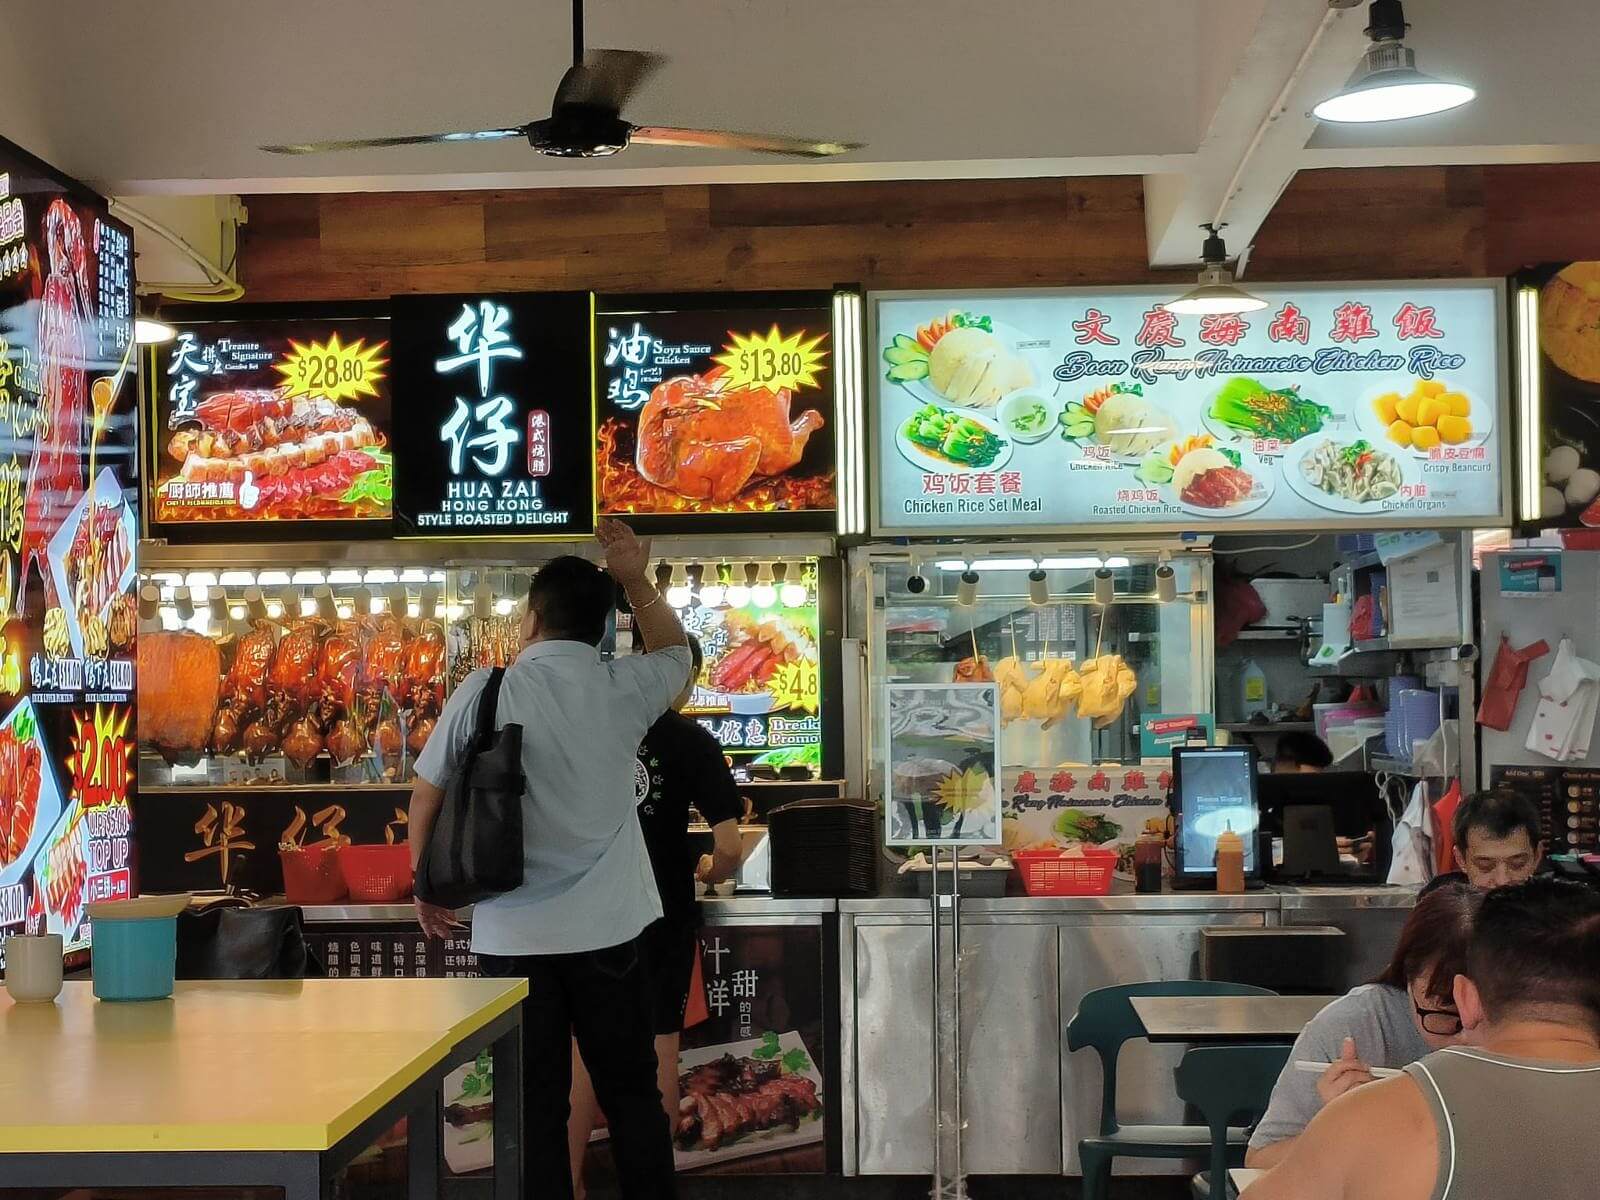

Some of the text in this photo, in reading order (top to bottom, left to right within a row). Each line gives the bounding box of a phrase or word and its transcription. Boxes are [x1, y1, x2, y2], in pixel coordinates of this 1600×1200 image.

[217, 337, 260, 353] Treasure
[652, 339, 711, 358] Soya Sauce
[231, 351, 273, 363] Signature
[655, 356, 690, 365] Chicken
[1053, 350, 1130, 381] Boon
[1193, 348, 1314, 380] Hainanese
[1311, 346, 1407, 375] Chicken
[1406, 344, 1466, 381] Rice
[298, 354, 363, 389] $28.80
[740, 348, 802, 383] $13.80
[434, 301, 523, 476] 华仔
[1082, 445, 1111, 459] 鸡饭
[1258, 455, 1274, 466] Veg
[1423, 462, 1492, 473] Crispy Beancurd
[448, 481, 538, 498] HUA ZAI
[922, 471, 1023, 495] 鸡饭套餐
[441, 499, 543, 512] HONG KONG
[904, 496, 1042, 514] Chicken Rice Set Meal
[1093, 503, 1182, 516] Roasted Chicken Rice
[1382, 499, 1447, 511] Chicken Organs
[417, 511, 569, 526] STYLE ROASTED DELIGHT
[771, 718, 820, 731] Break
[771, 734, 820, 745] Promo
[74, 720, 127, 807] $2.00
[88, 838, 128, 872] TOP UP
